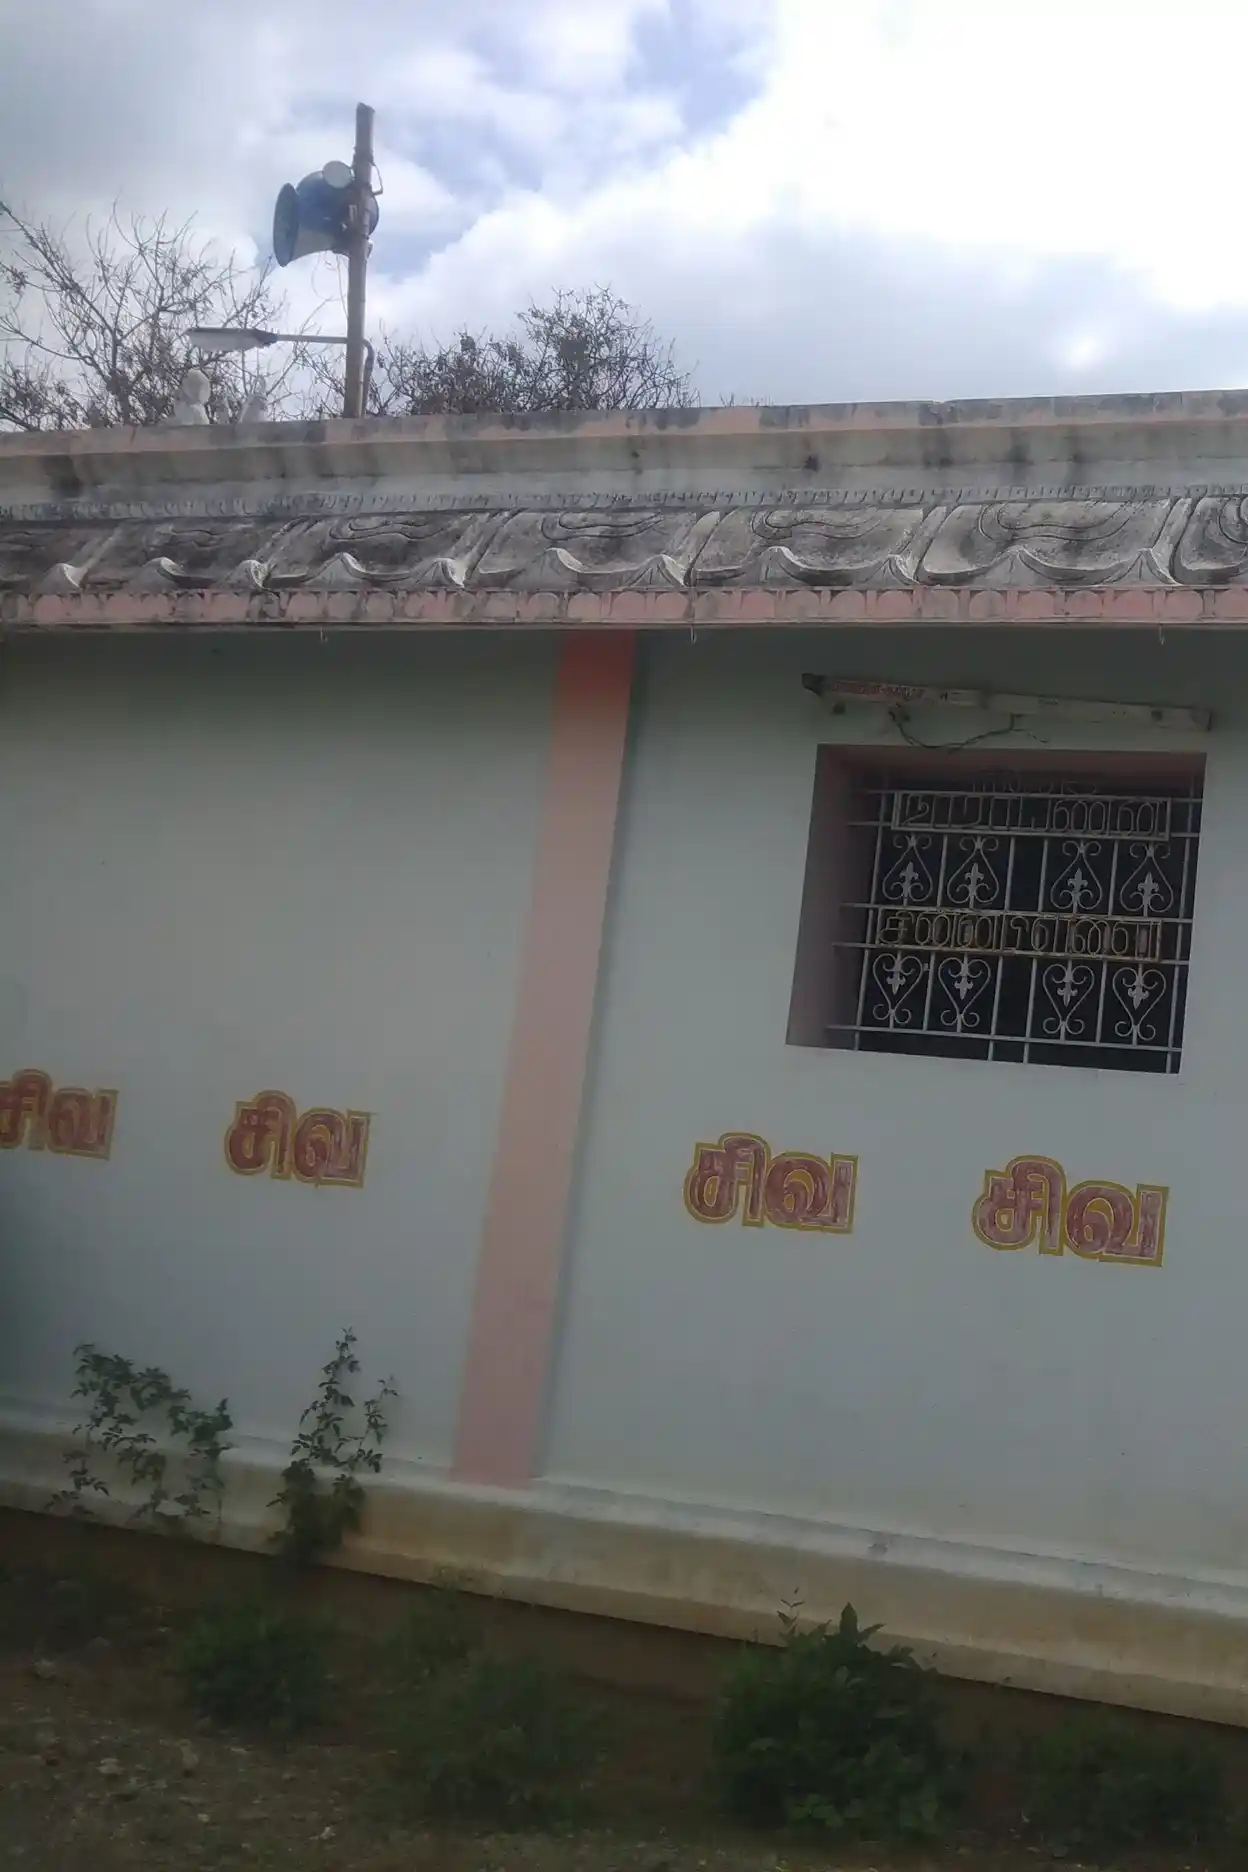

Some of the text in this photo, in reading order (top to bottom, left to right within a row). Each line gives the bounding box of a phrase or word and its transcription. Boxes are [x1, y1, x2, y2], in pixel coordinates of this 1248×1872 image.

[224, 1089, 372, 1189] சிவ
[683, 1131, 858, 1234] சிவ
[971, 1155, 1170, 1267] சிவ
